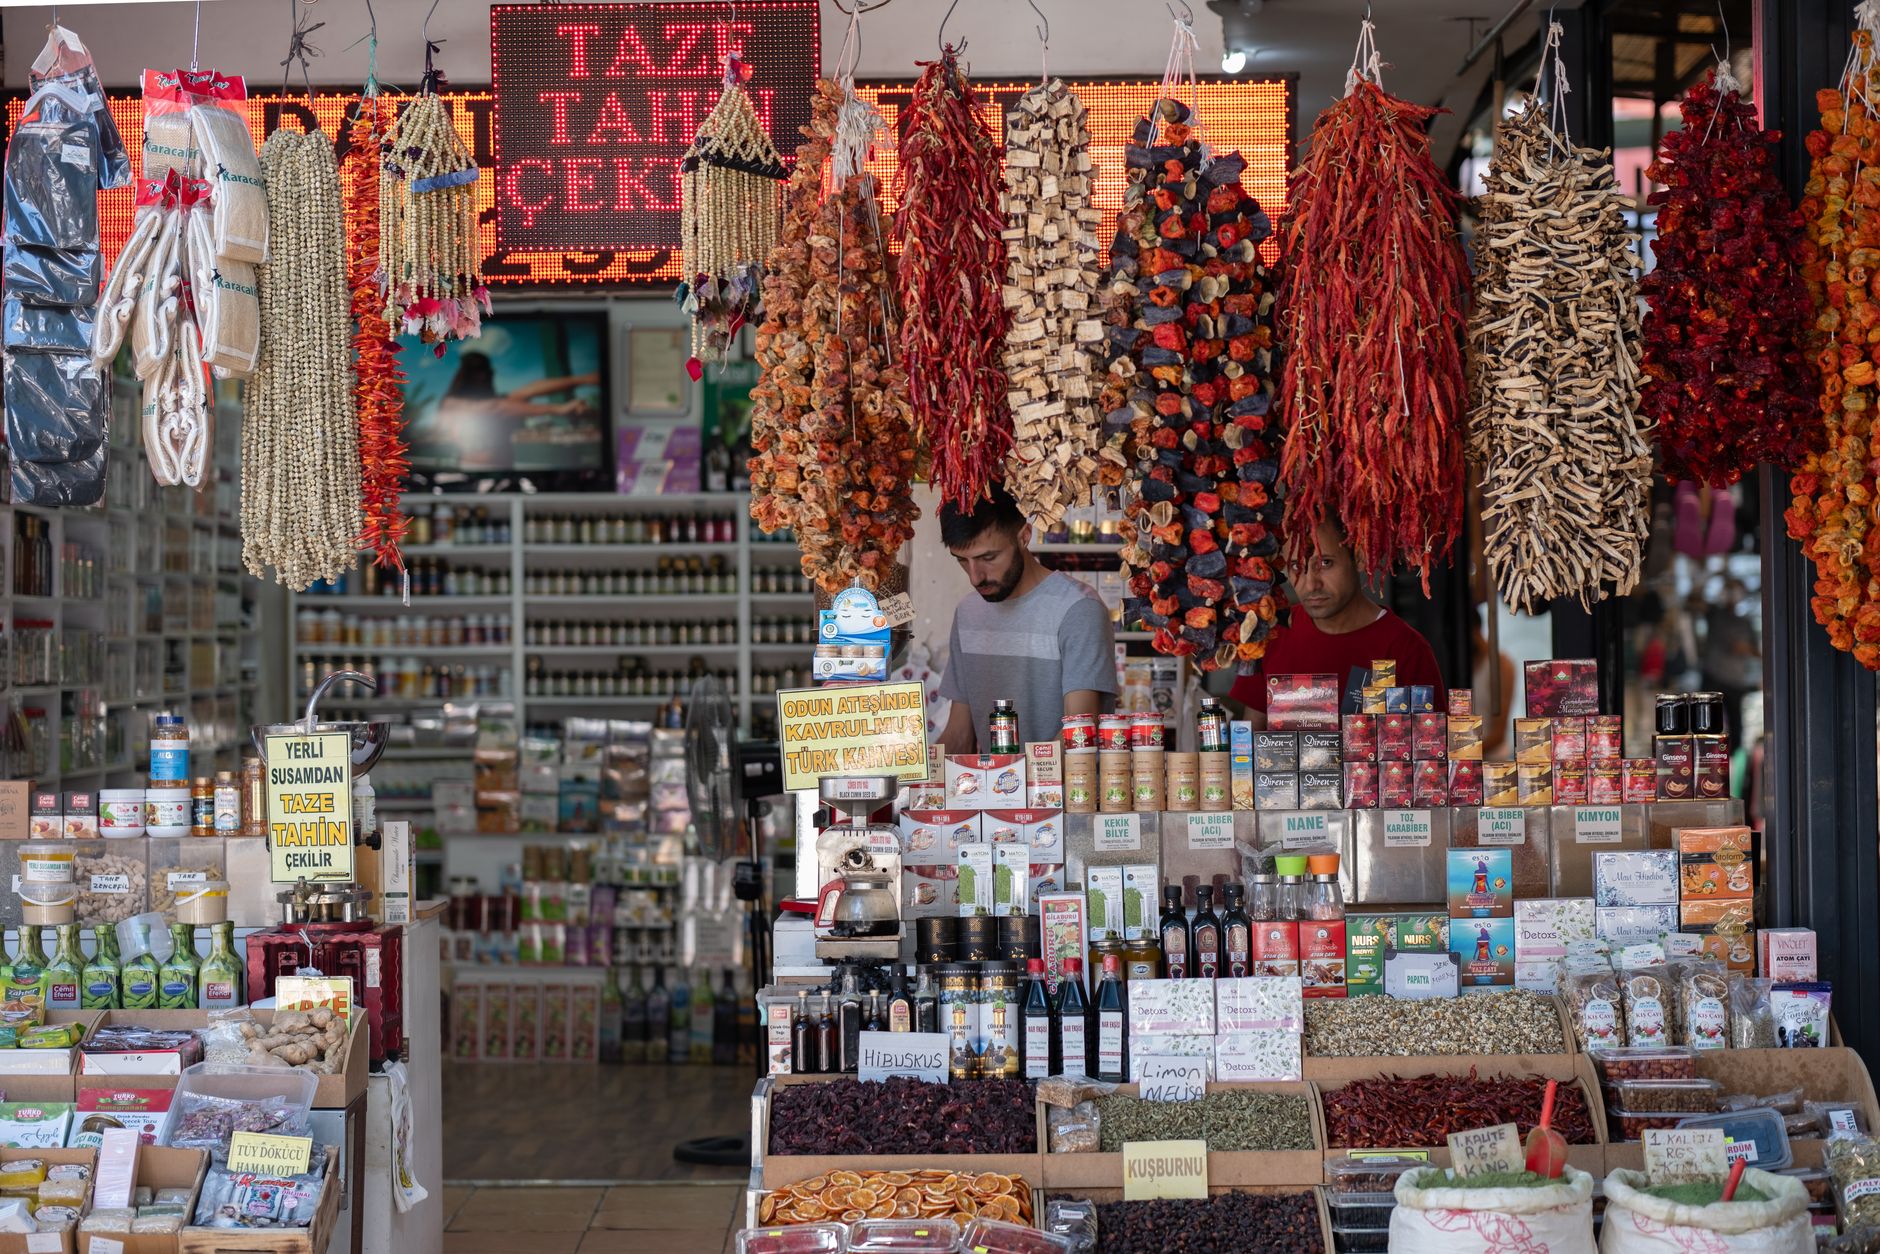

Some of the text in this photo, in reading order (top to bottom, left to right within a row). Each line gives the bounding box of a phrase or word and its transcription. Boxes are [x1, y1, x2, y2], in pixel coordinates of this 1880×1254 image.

[783, 690, 921, 718] ODUN ATEŞİNDE
[785, 714, 924, 742] KAVRULMUŞ
[285, 737, 323, 760] YERLİ
[786, 746, 839, 775] TÜRK
[843, 737, 925, 771] KAHVESİ
[1662, 754, 1687, 762] Ginseng
[1706, 752, 1728, 760] Ginseng
[271, 766, 343, 785] SUSAMDAN
[280, 793, 335, 814] TAZE
[1189, 813, 1233, 825] PUL BİBER
[1400, 813, 1414, 822] TOZ
[1480, 809, 1523, 821] PUL BİBER
[1577, 809, 1620, 822] KİMYON
[1104, 816, 1130, 827] KEKİK
[1287, 816, 1324, 831] NANE
[1491, 821, 1512, 831] (ACI)
[272, 816, 347, 848] TAHİN
[1105, 827, 1129, 838] BİLYE
[1387, 823, 1428, 833] KARABİBER
[285, 849, 332, 871] ÇEKİLİR
[1351, 935, 1380, 946] NURS
[1404, 934, 1432, 944] NURS
[1407, 975, 1430, 985] PAPATYA
[54, 984, 74, 992] Cemil
[208, 983, 230, 991] Cemil
[1138, 1006, 1168, 1015] Detoxs
[1227, 1005, 1257, 1014] Detoxs
[1142, 1061, 1201, 1079] Limon
[1225, 1062, 1256, 1071] Detoxs
[237, 1143, 304, 1161] TÜY DÖKÜCÜ
[1727, 1143, 1753, 1154] RDÜM
[236, 1162, 300, 1177] HAMAM OTU
[1127, 1157, 1203, 1182] KUŞBURNU
[1846, 1179, 1880, 1194] ANTALY
